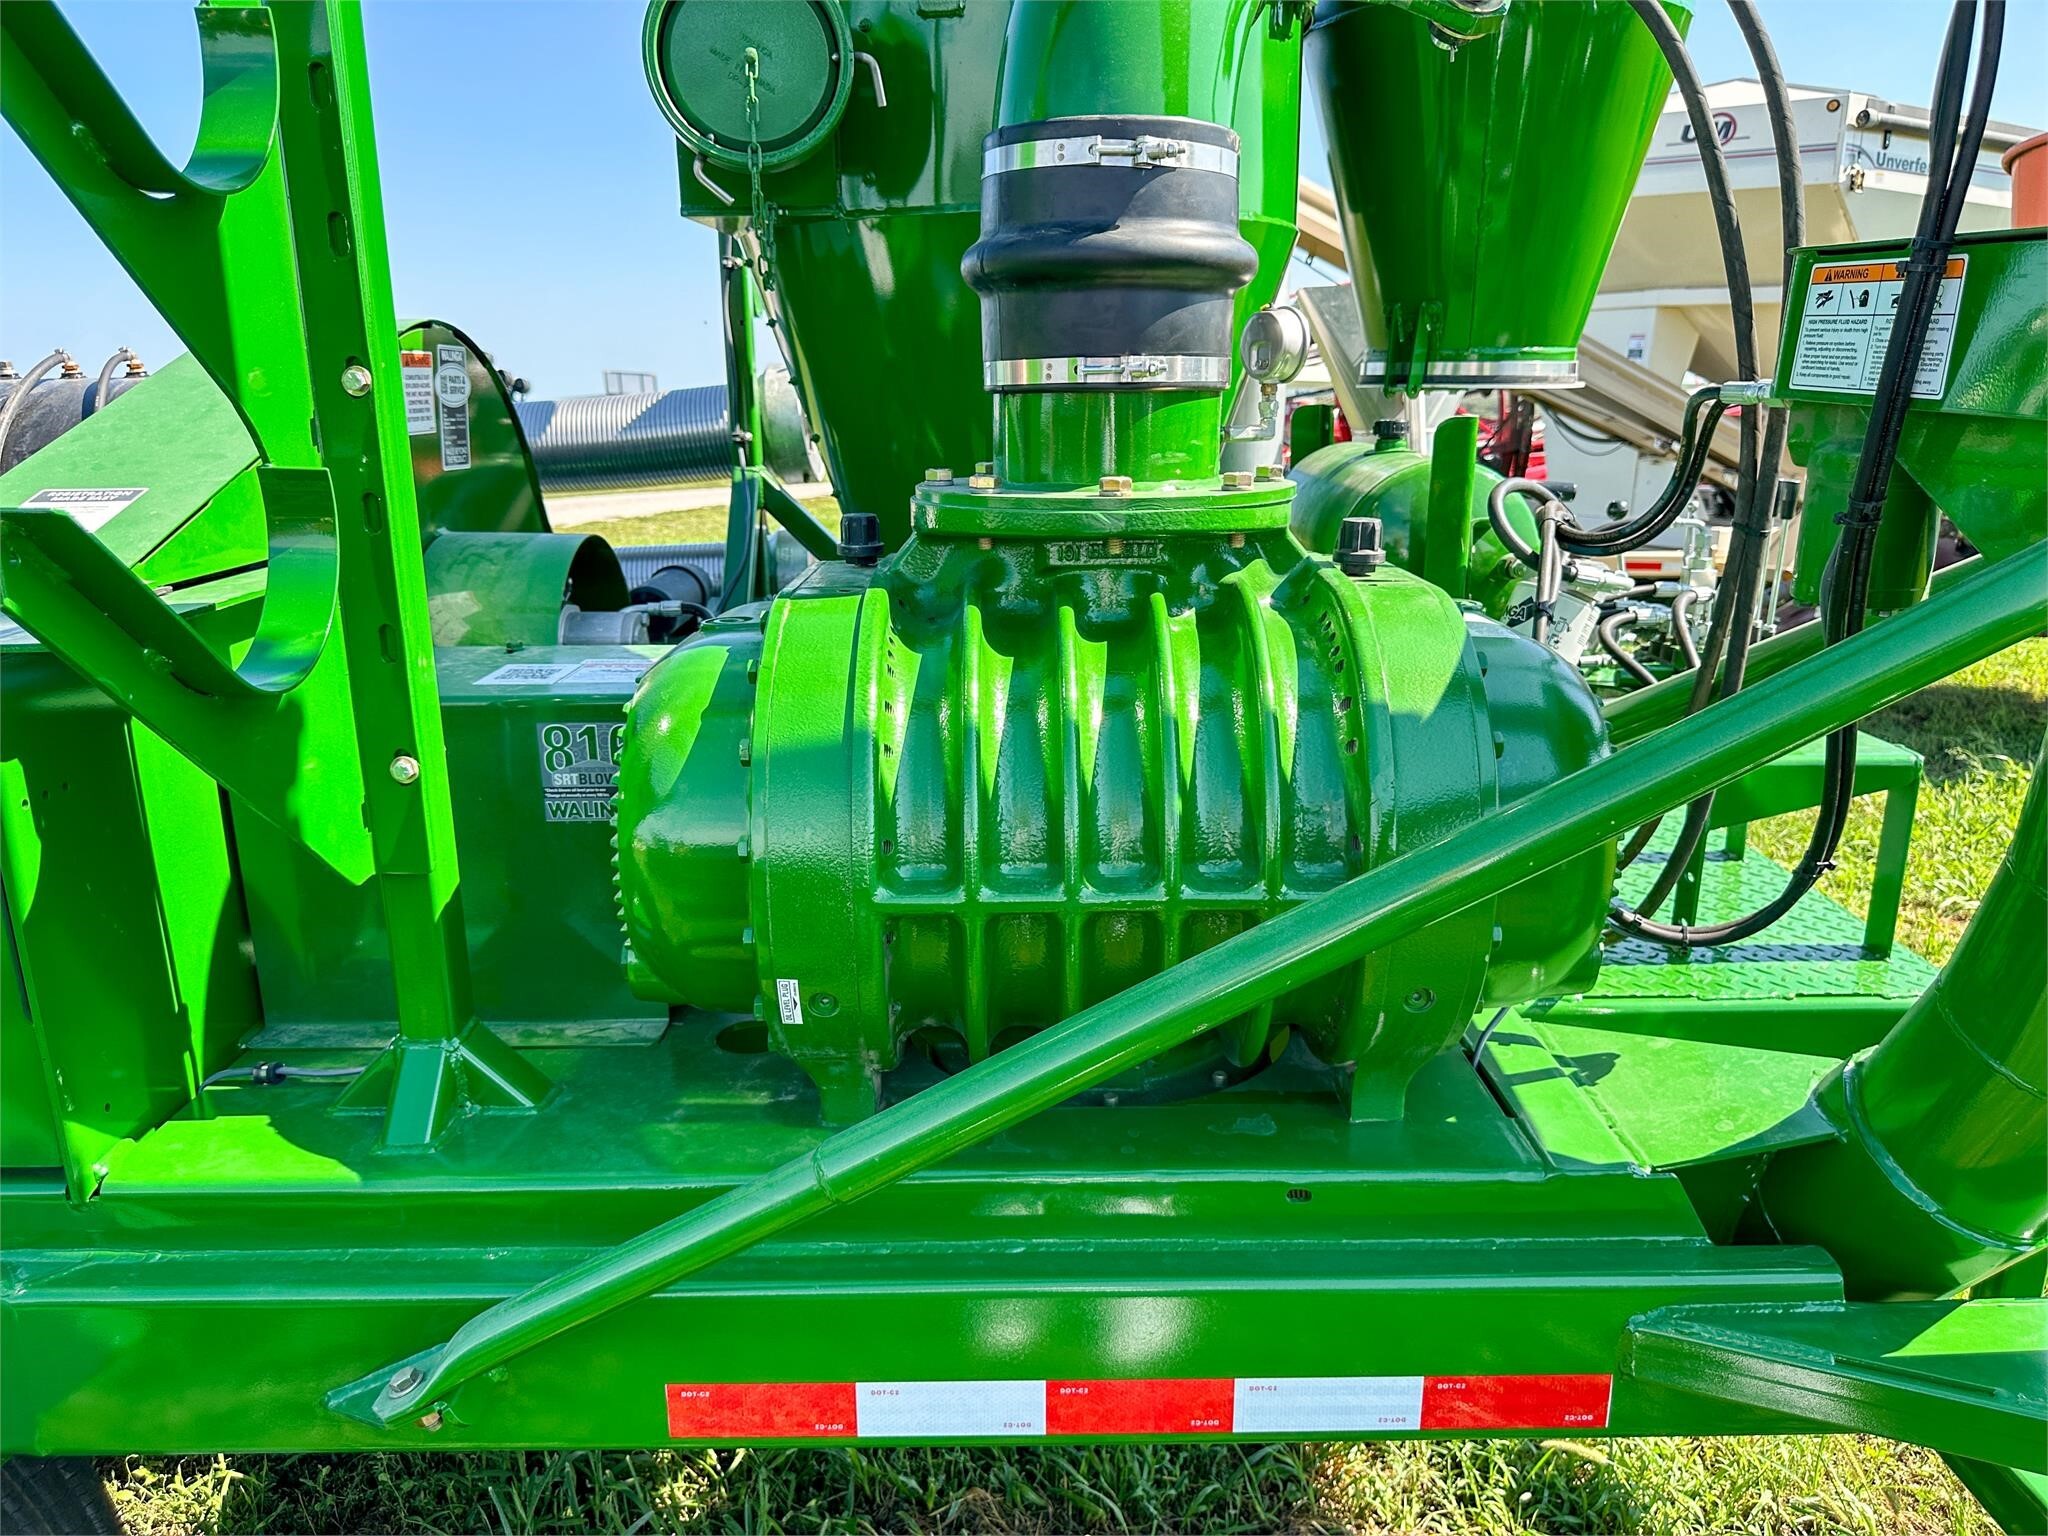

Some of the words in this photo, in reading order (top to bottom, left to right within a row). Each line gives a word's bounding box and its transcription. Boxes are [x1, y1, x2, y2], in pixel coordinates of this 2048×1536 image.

[1876, 151, 1928, 173] Unverfe
[1833, 268, 1870, 281] WARNING
[545, 800, 618, 819] WALIN
[1059, 1387, 1089, 1395] DOT-C2
[1437, 1382, 1466, 1390] DOT-C2
